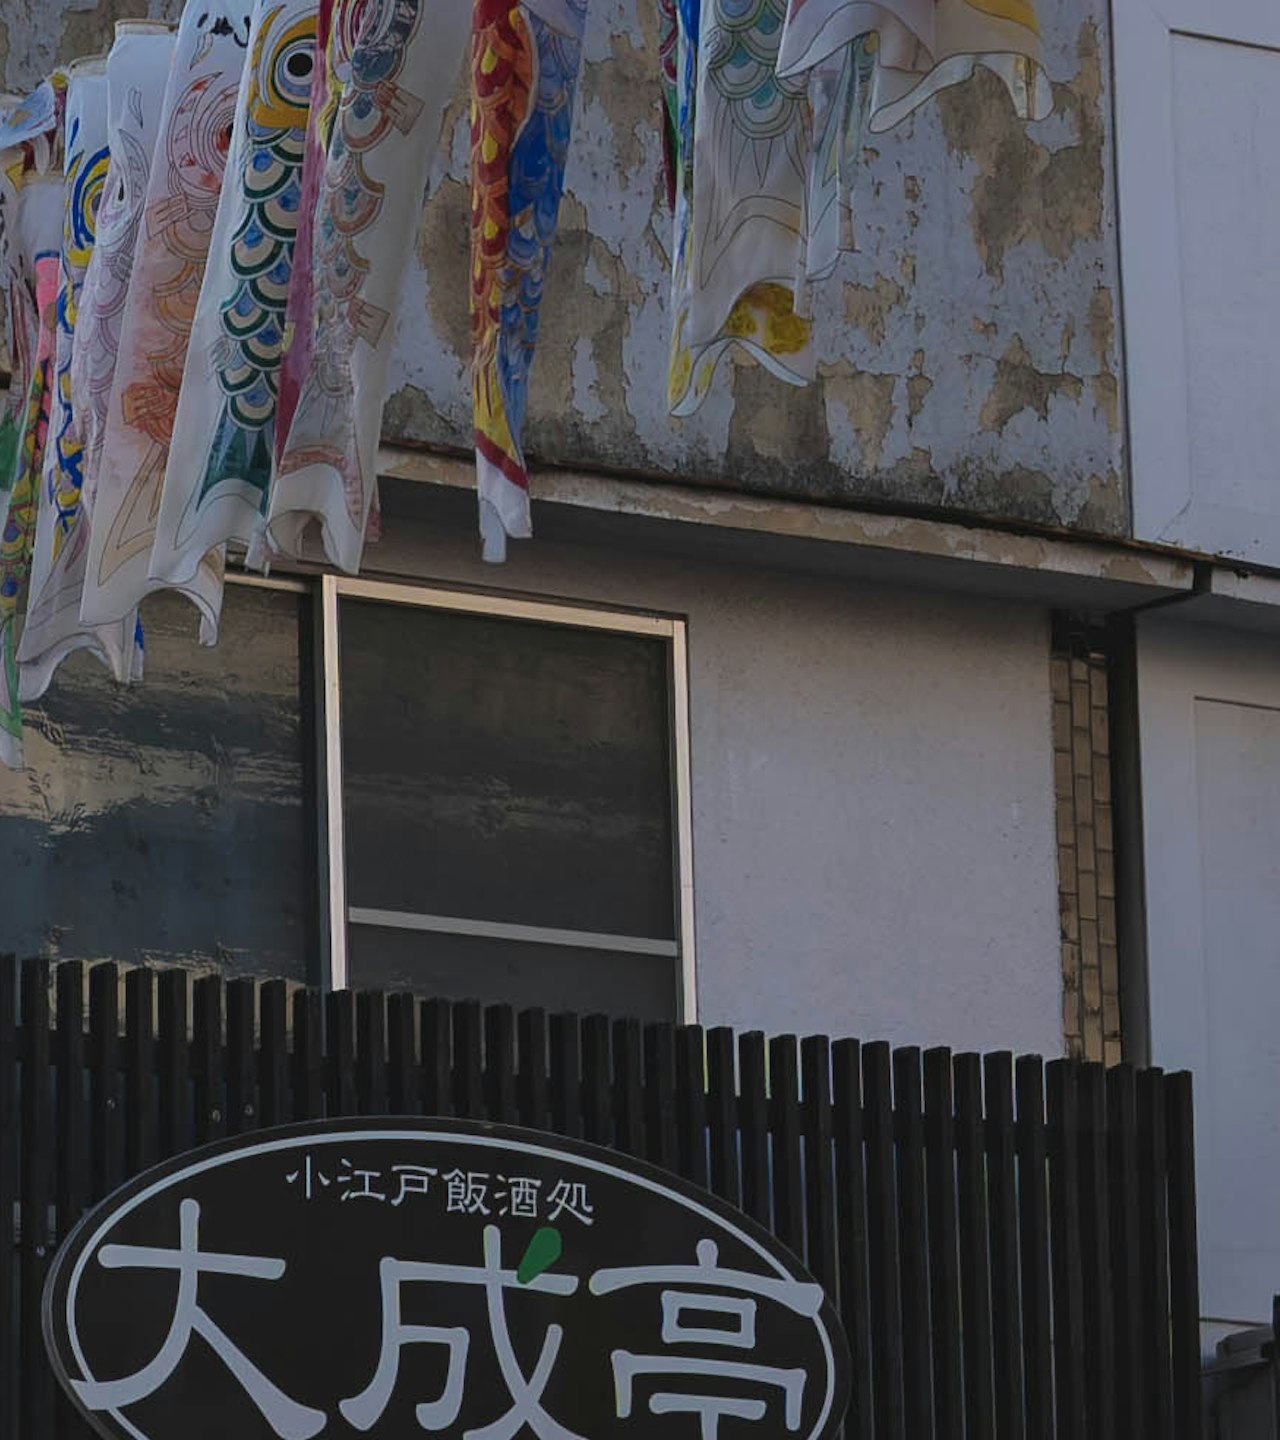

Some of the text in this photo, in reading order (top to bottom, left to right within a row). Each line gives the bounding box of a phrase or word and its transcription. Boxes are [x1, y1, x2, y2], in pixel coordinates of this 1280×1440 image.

[285, 1154, 596, 1227] 小江戸飯酒処
